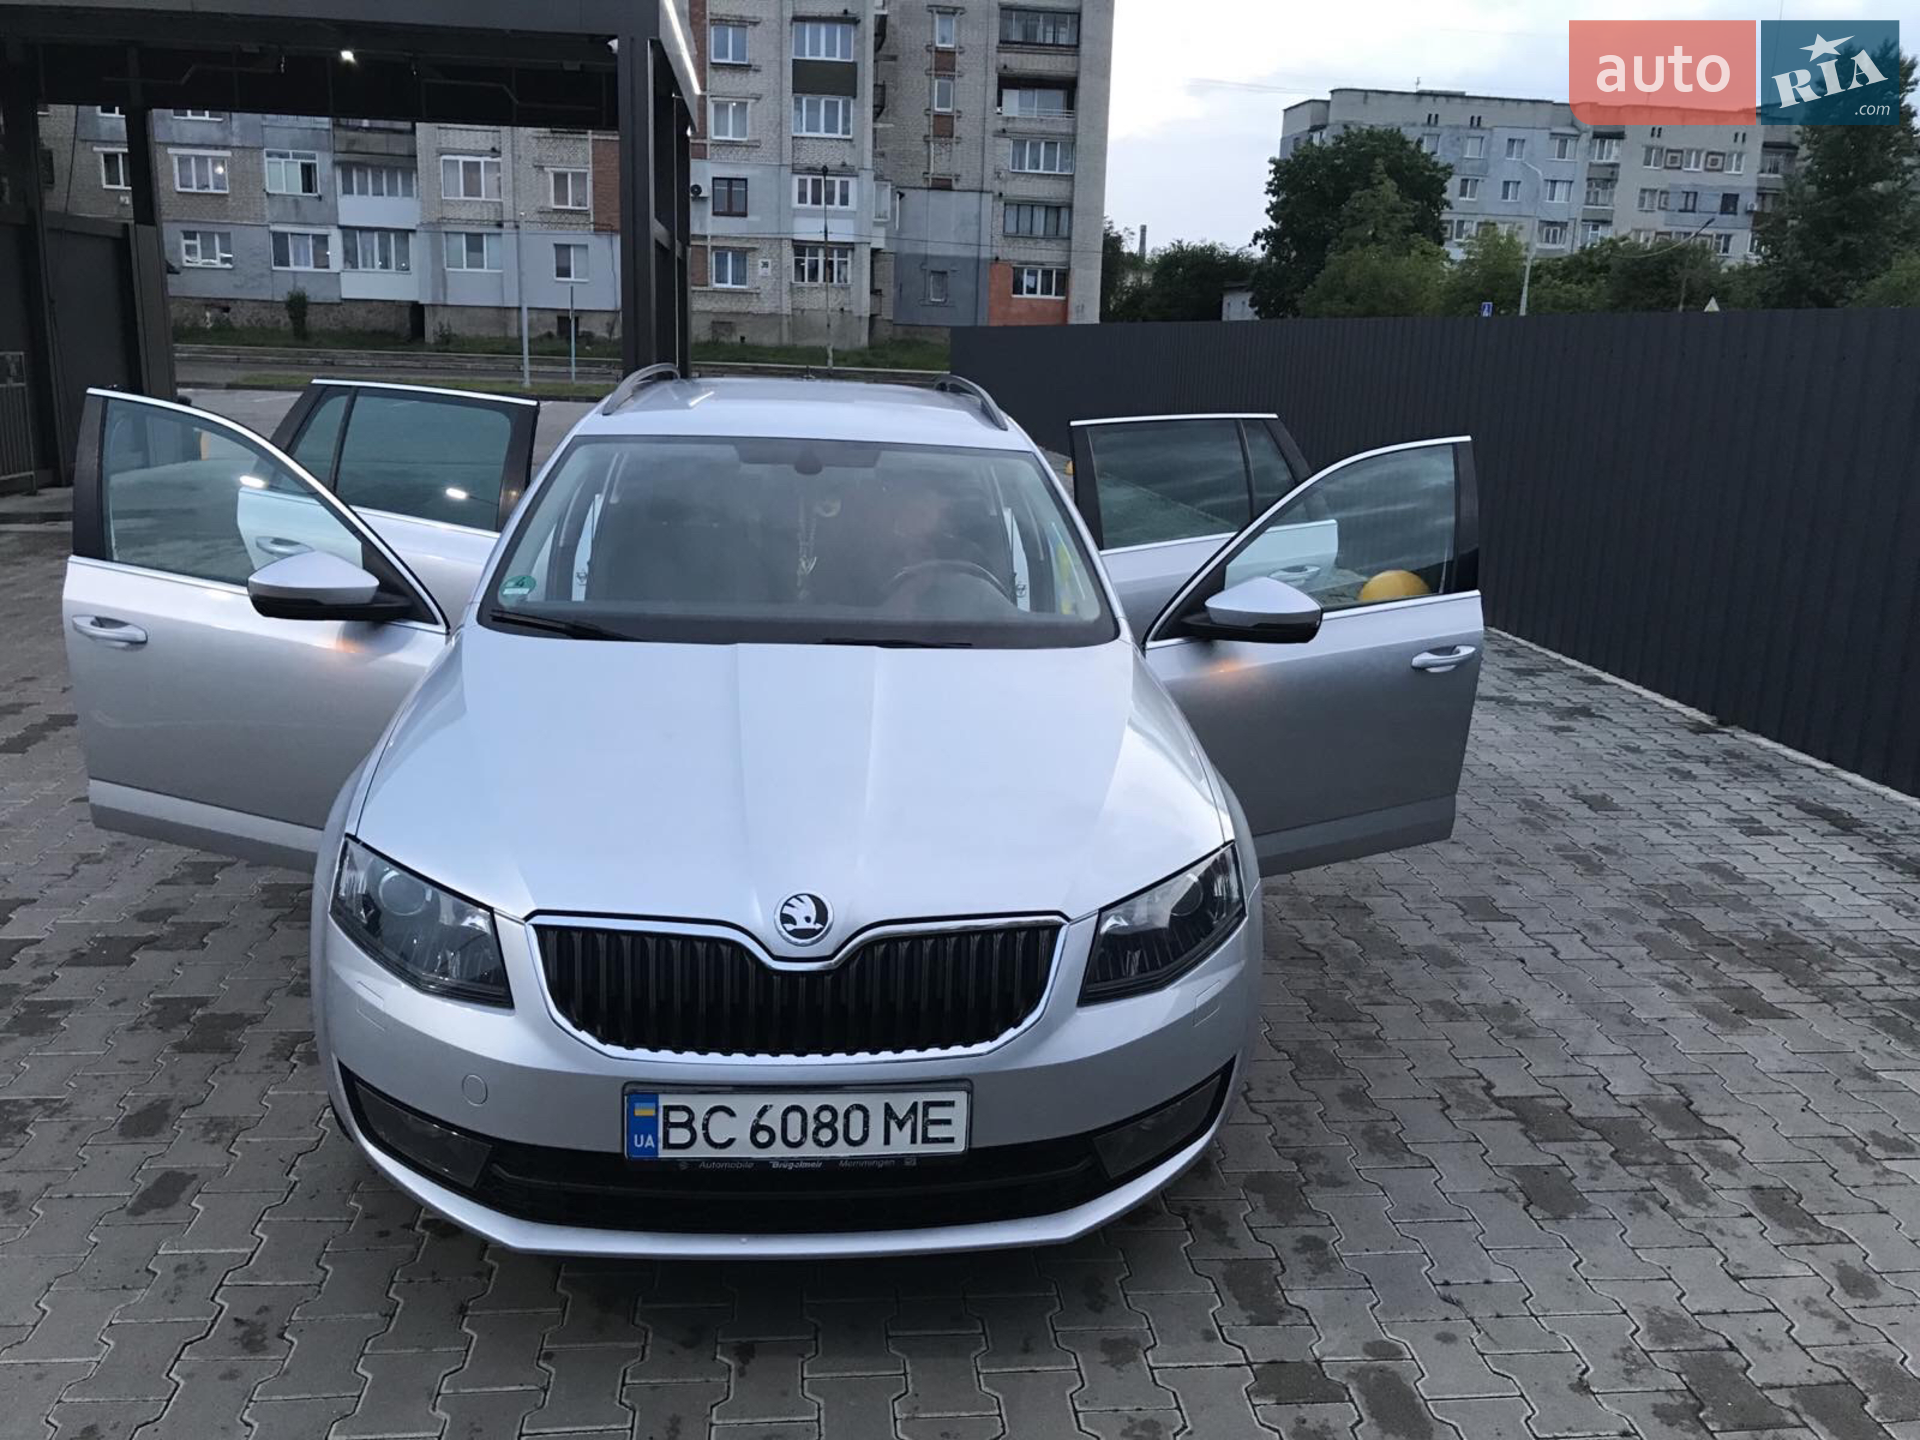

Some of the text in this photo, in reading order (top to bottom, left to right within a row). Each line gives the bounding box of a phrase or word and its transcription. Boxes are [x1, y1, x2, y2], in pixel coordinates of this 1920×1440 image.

[633, 1133, 655, 1149] UA
[662, 1100, 956, 1151] BC 6080 ME
